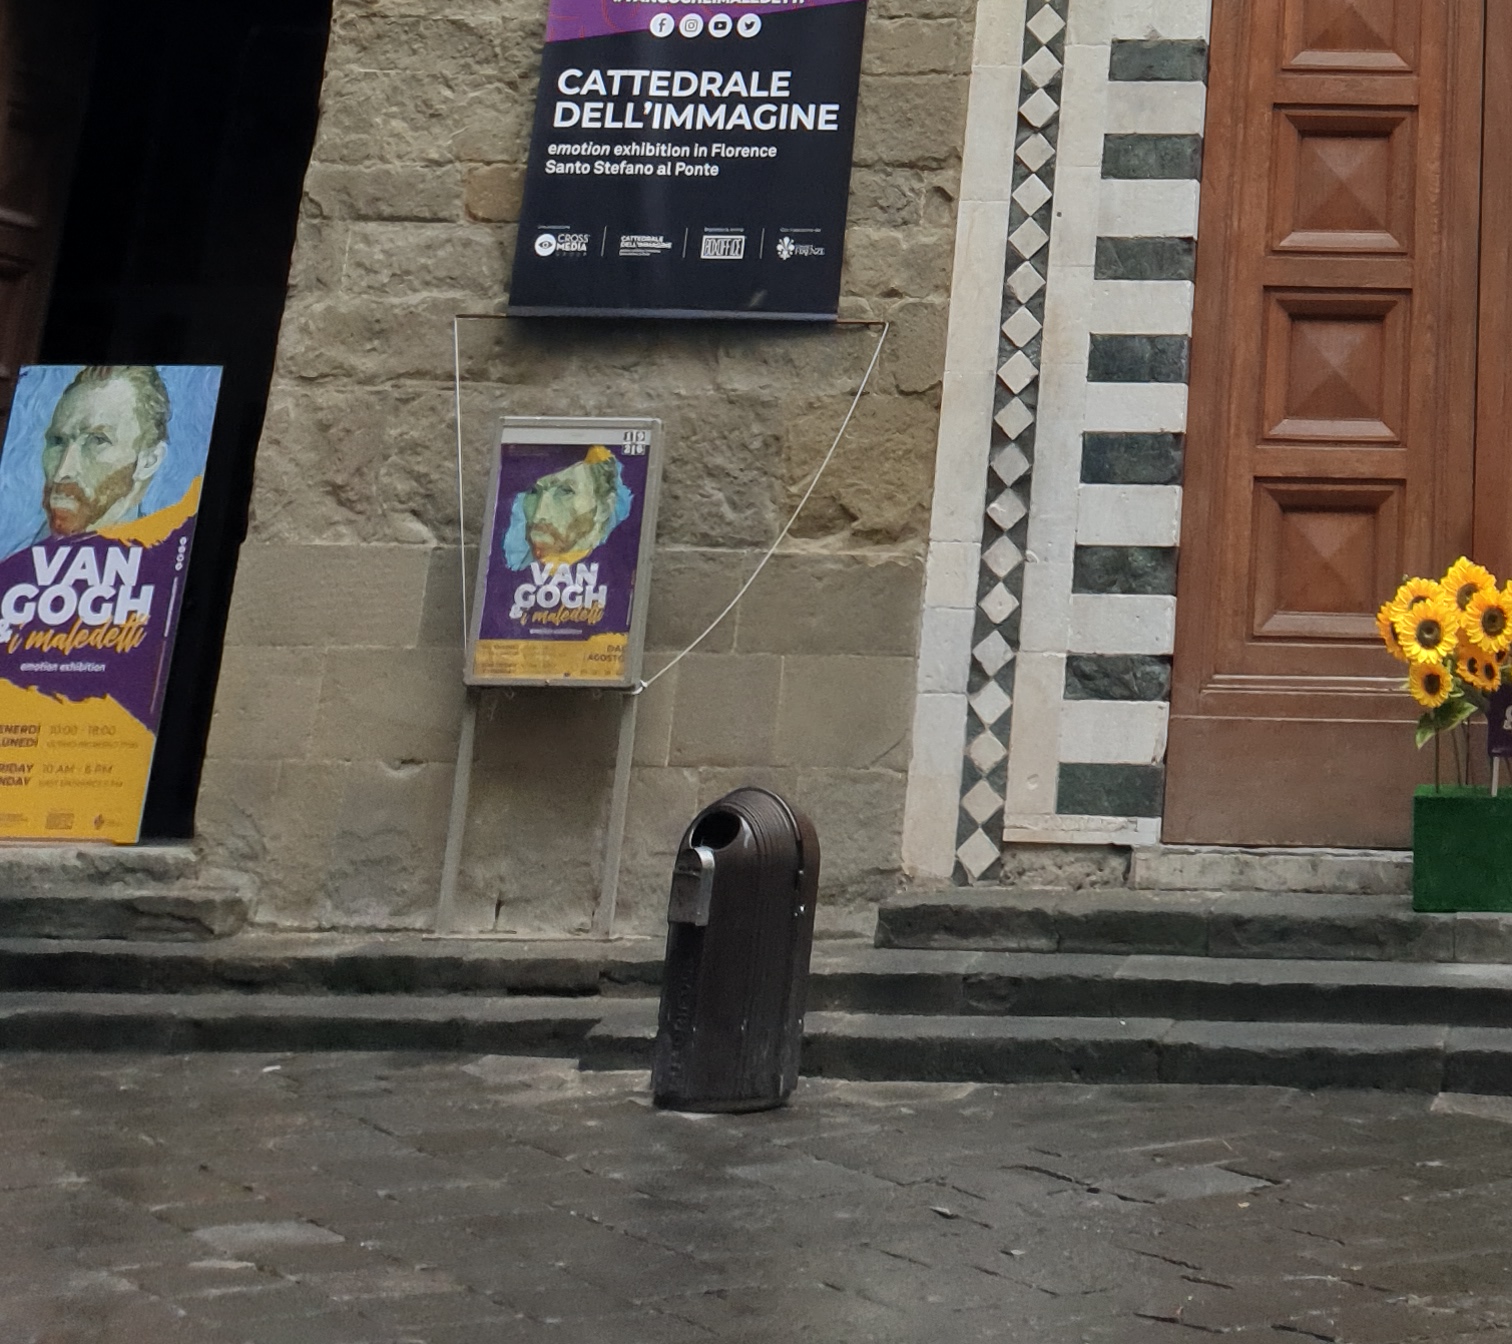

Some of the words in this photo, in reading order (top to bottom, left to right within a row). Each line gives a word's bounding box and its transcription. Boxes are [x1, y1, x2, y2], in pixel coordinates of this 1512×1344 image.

[557, 68, 792, 98] CATTEDRALE
[553, 101, 840, 131] DELL'IMMAGINE
[548, 141, 611, 156] emotion
[613, 142, 690, 158] exhibition
[693, 143, 708, 158] in
[711, 143, 777, 158] Florence
[545, 160, 591, 175] Santo
[594, 160, 654, 176] Stefano
[657, 161, 672, 176] al
[675, 162, 720, 177] Ponte
[556, 242, 587, 252] MEDIA
[557, 234, 589, 243] CROSS
[32, 546, 143, 586] VAN
[530, 561, 600, 586] VAN
[1, 583, 155, 625] GOGH
[514, 583, 608, 609] GOGH
[25, 613, 151, 655] maledetti
[20, 661, 58, 672] emotion
[59, 661, 106, 672] exhibition
